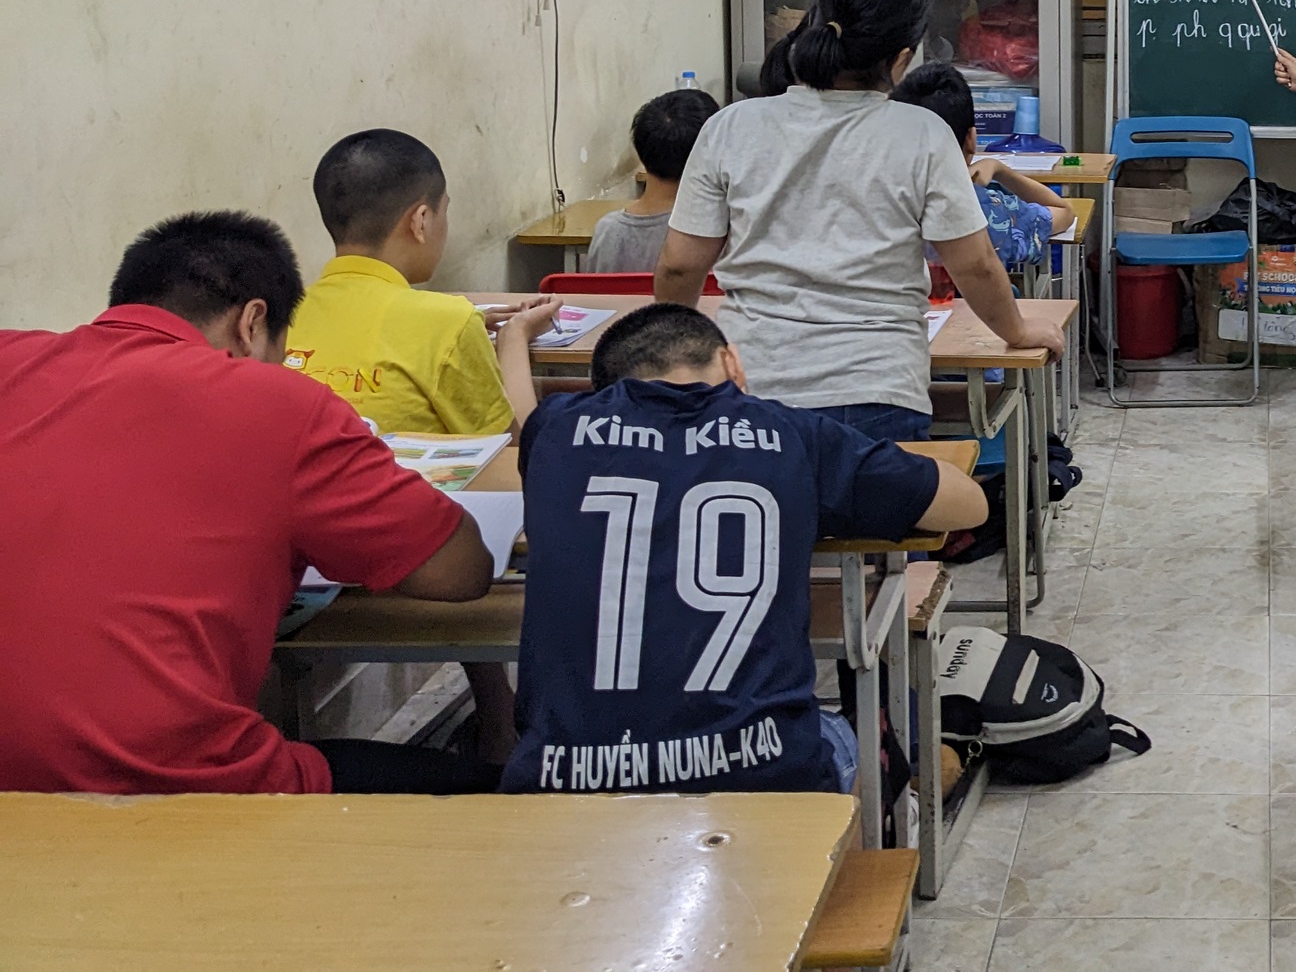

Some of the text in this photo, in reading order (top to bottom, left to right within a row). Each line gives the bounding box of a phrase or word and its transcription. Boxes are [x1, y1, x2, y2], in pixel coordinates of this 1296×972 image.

[1172, 10, 1206, 48] ph
[572, 414, 782, 455] Kim Kiều
[580, 475, 780, 692] 19
[940, 638, 973, 679] sunday
[540, 716, 783, 790] FC HUYỀN NUNA-K40
